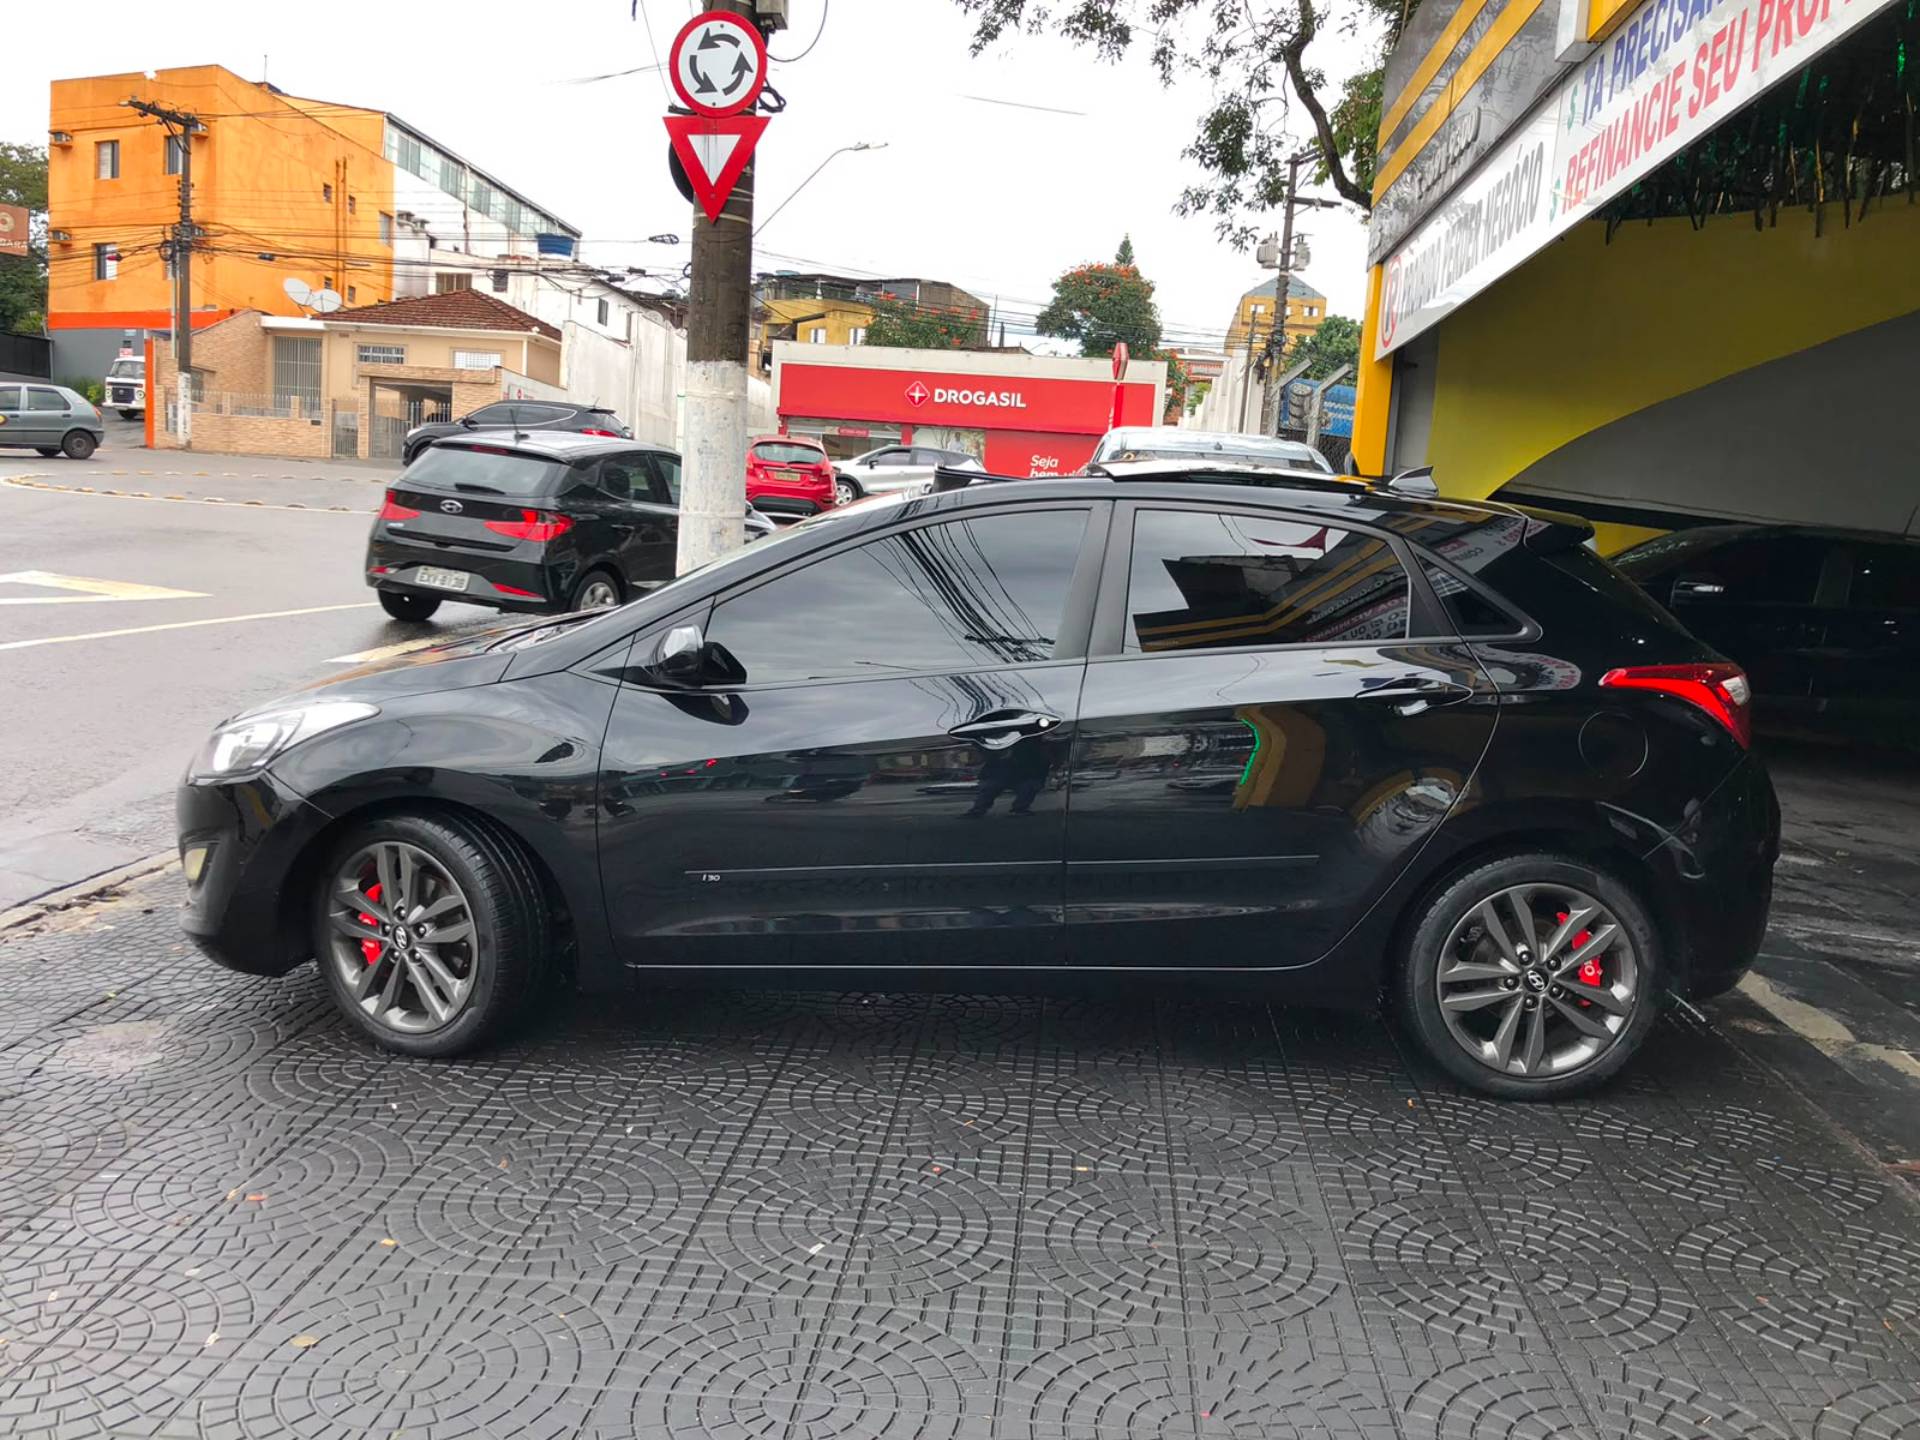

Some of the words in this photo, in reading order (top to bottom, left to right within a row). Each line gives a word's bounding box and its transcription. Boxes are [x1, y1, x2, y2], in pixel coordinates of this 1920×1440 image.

[1562, 60, 1687, 215] REFINANCIE
[1688, 8, 1749, 119] SEU
[1582, 54, 1605, 126] TA
[1482, 141, 1544, 261] NEGÓCIO
[933, 388, 1027, 408] DROGASIL
[1030, 455, 1059, 470] Seja
